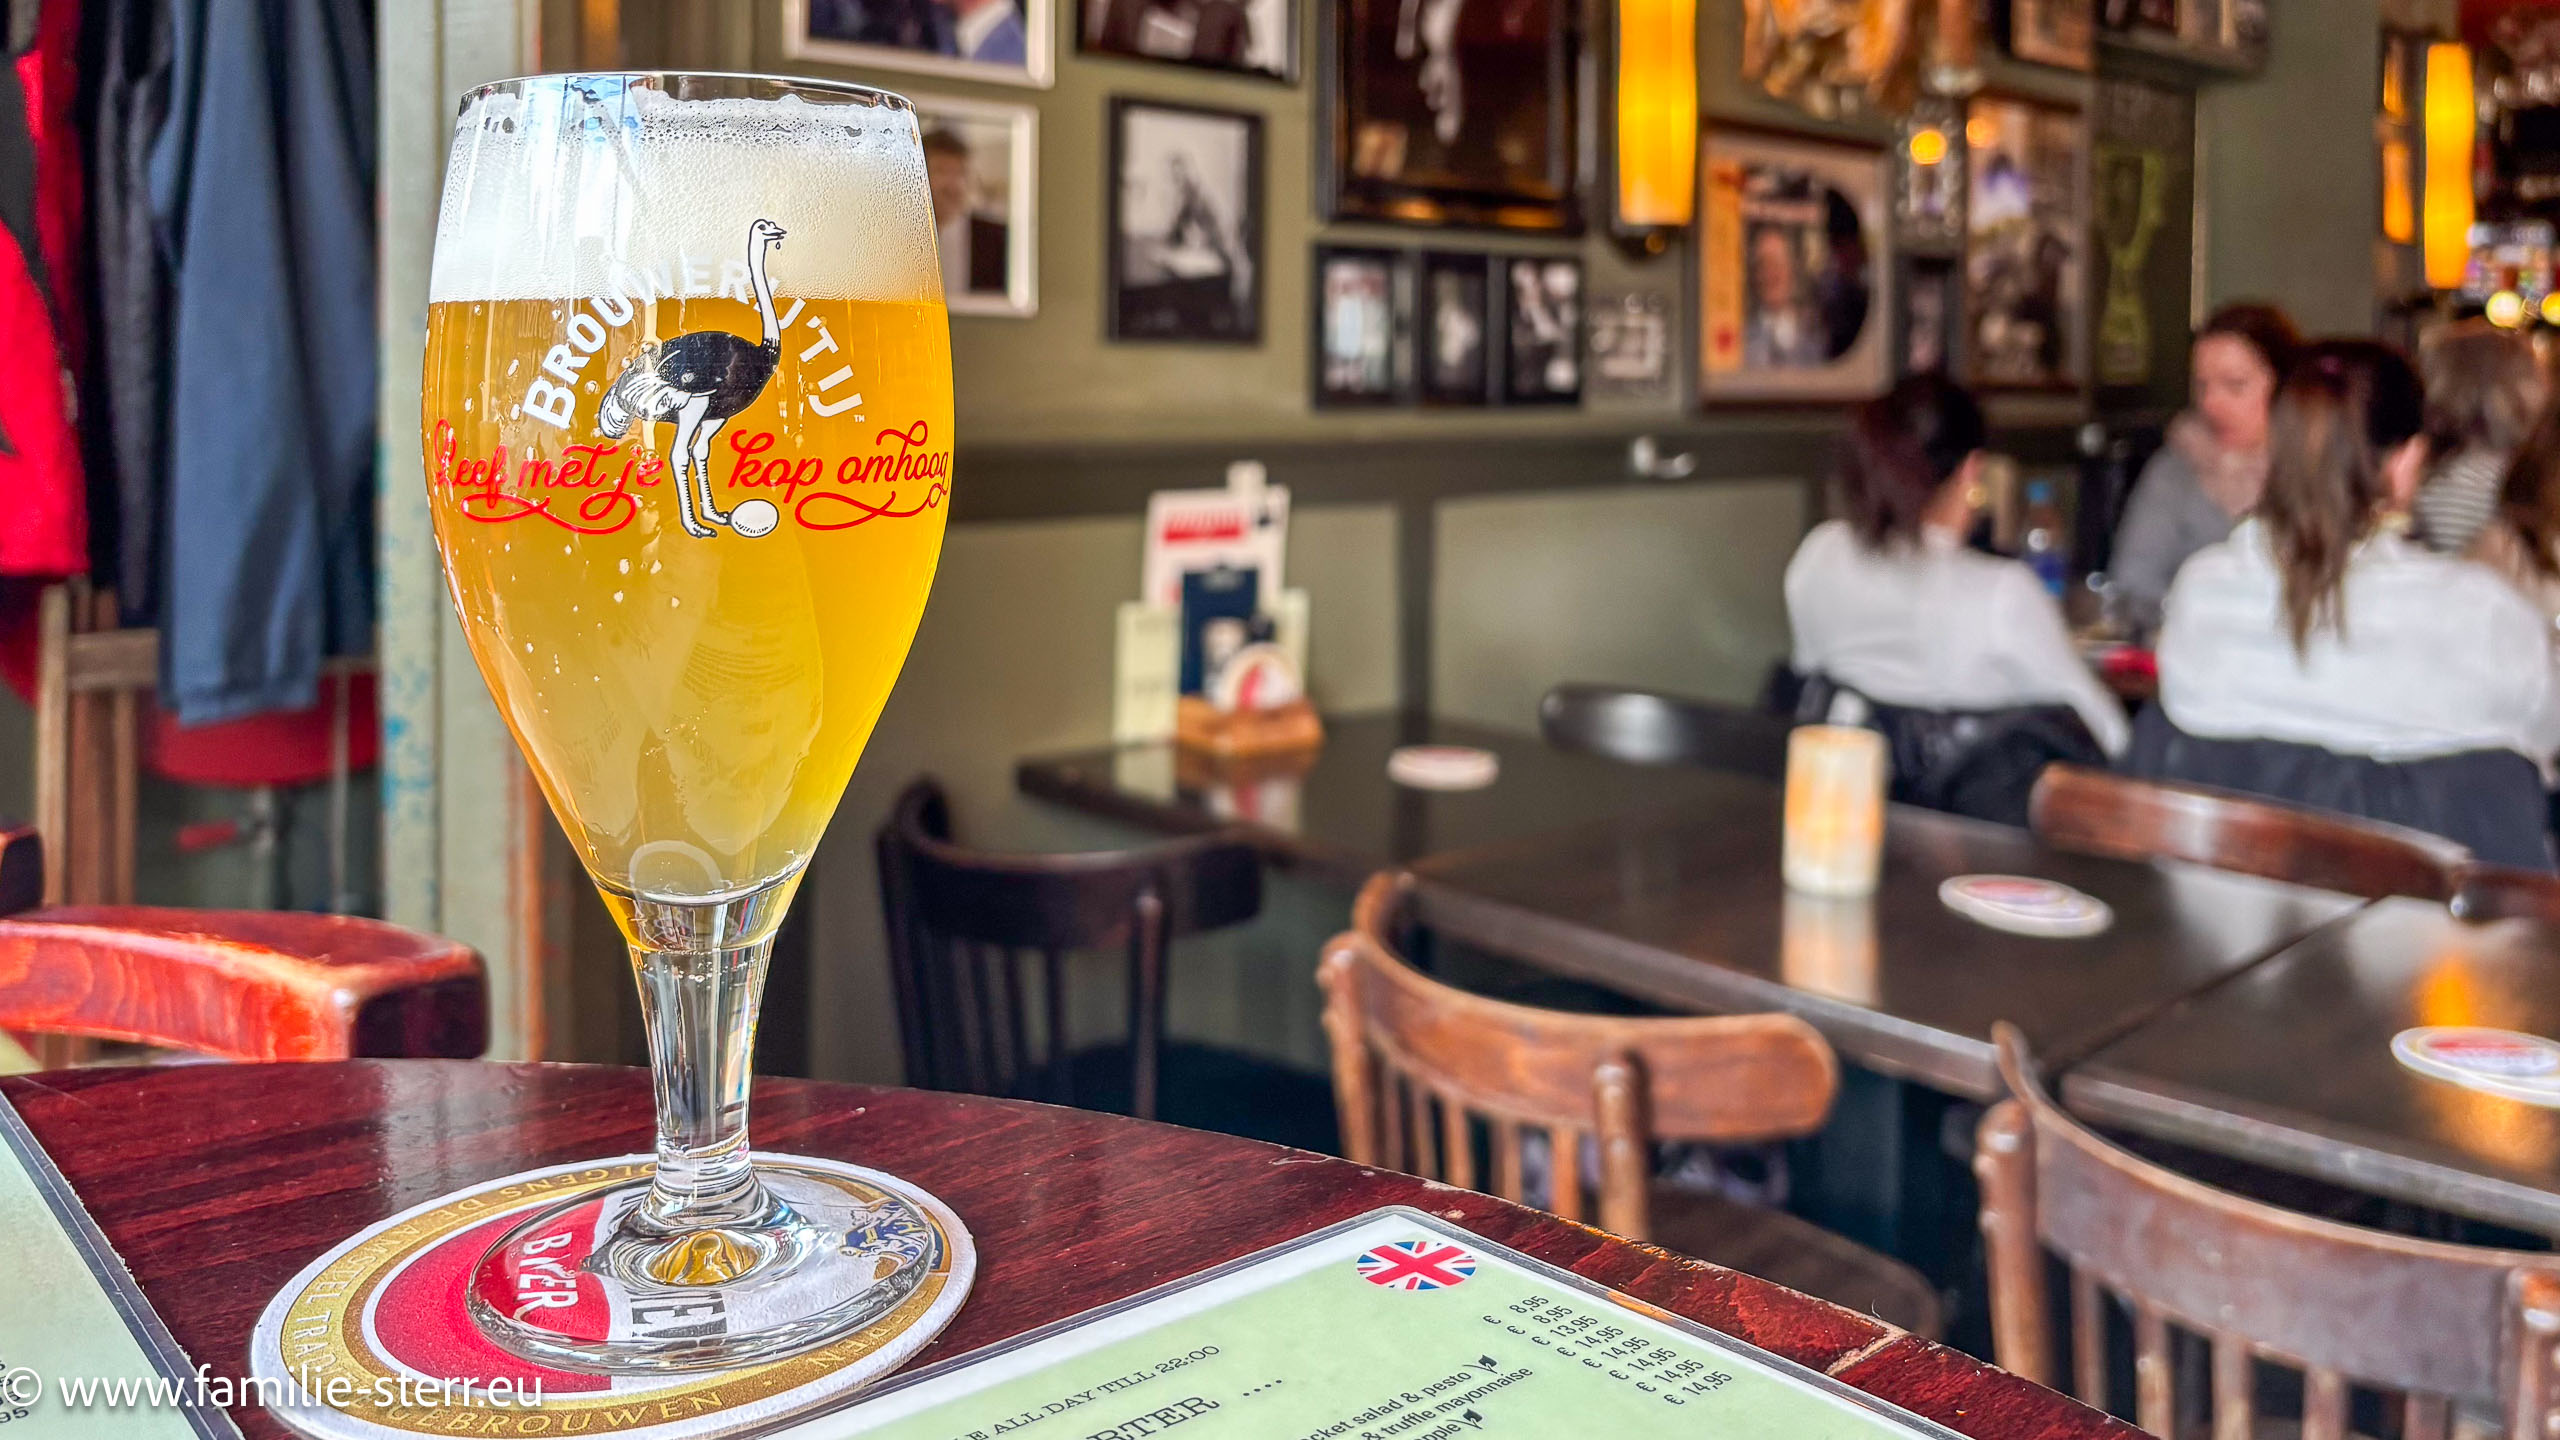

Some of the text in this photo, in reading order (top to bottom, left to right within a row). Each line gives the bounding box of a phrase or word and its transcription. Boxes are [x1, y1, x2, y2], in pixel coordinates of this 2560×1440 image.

[516, 443, 619, 489] met
[728, 429, 823, 504] kop
[499, 1161, 659, 1198] OLGENS
[437, 1197, 486, 1222] DE
[305, 1224, 420, 1305] AMSTEL
[1509, 1295, 1550, 1315] 8,95
[1533, 1305, 1573, 1325] 8,95
[1550, 1315, 1598, 1338] 13,95
[1575, 1325, 1624, 1349] 14,95
[1601, 1336, 1650, 1360] 14,95
[1627, 1347, 1677, 1372] 14,95
[1654, 1359, 1705, 1384] 14,95
[1682, 1370, 1733, 1396] 14,95
[993, 1411, 1045, 1435] ALL
[1042, 1390, 1097, 1415] DAY
[1097, 1371, 1157, 1394] TILL
[1154, 1345, 1220, 1374] 22:00
[1380, 1409, 1437, 1438] truffle
[1434, 1367, 1533, 1414] mayonnaise
[1300, 1371, 1472, 1440] cket salad & pesto
